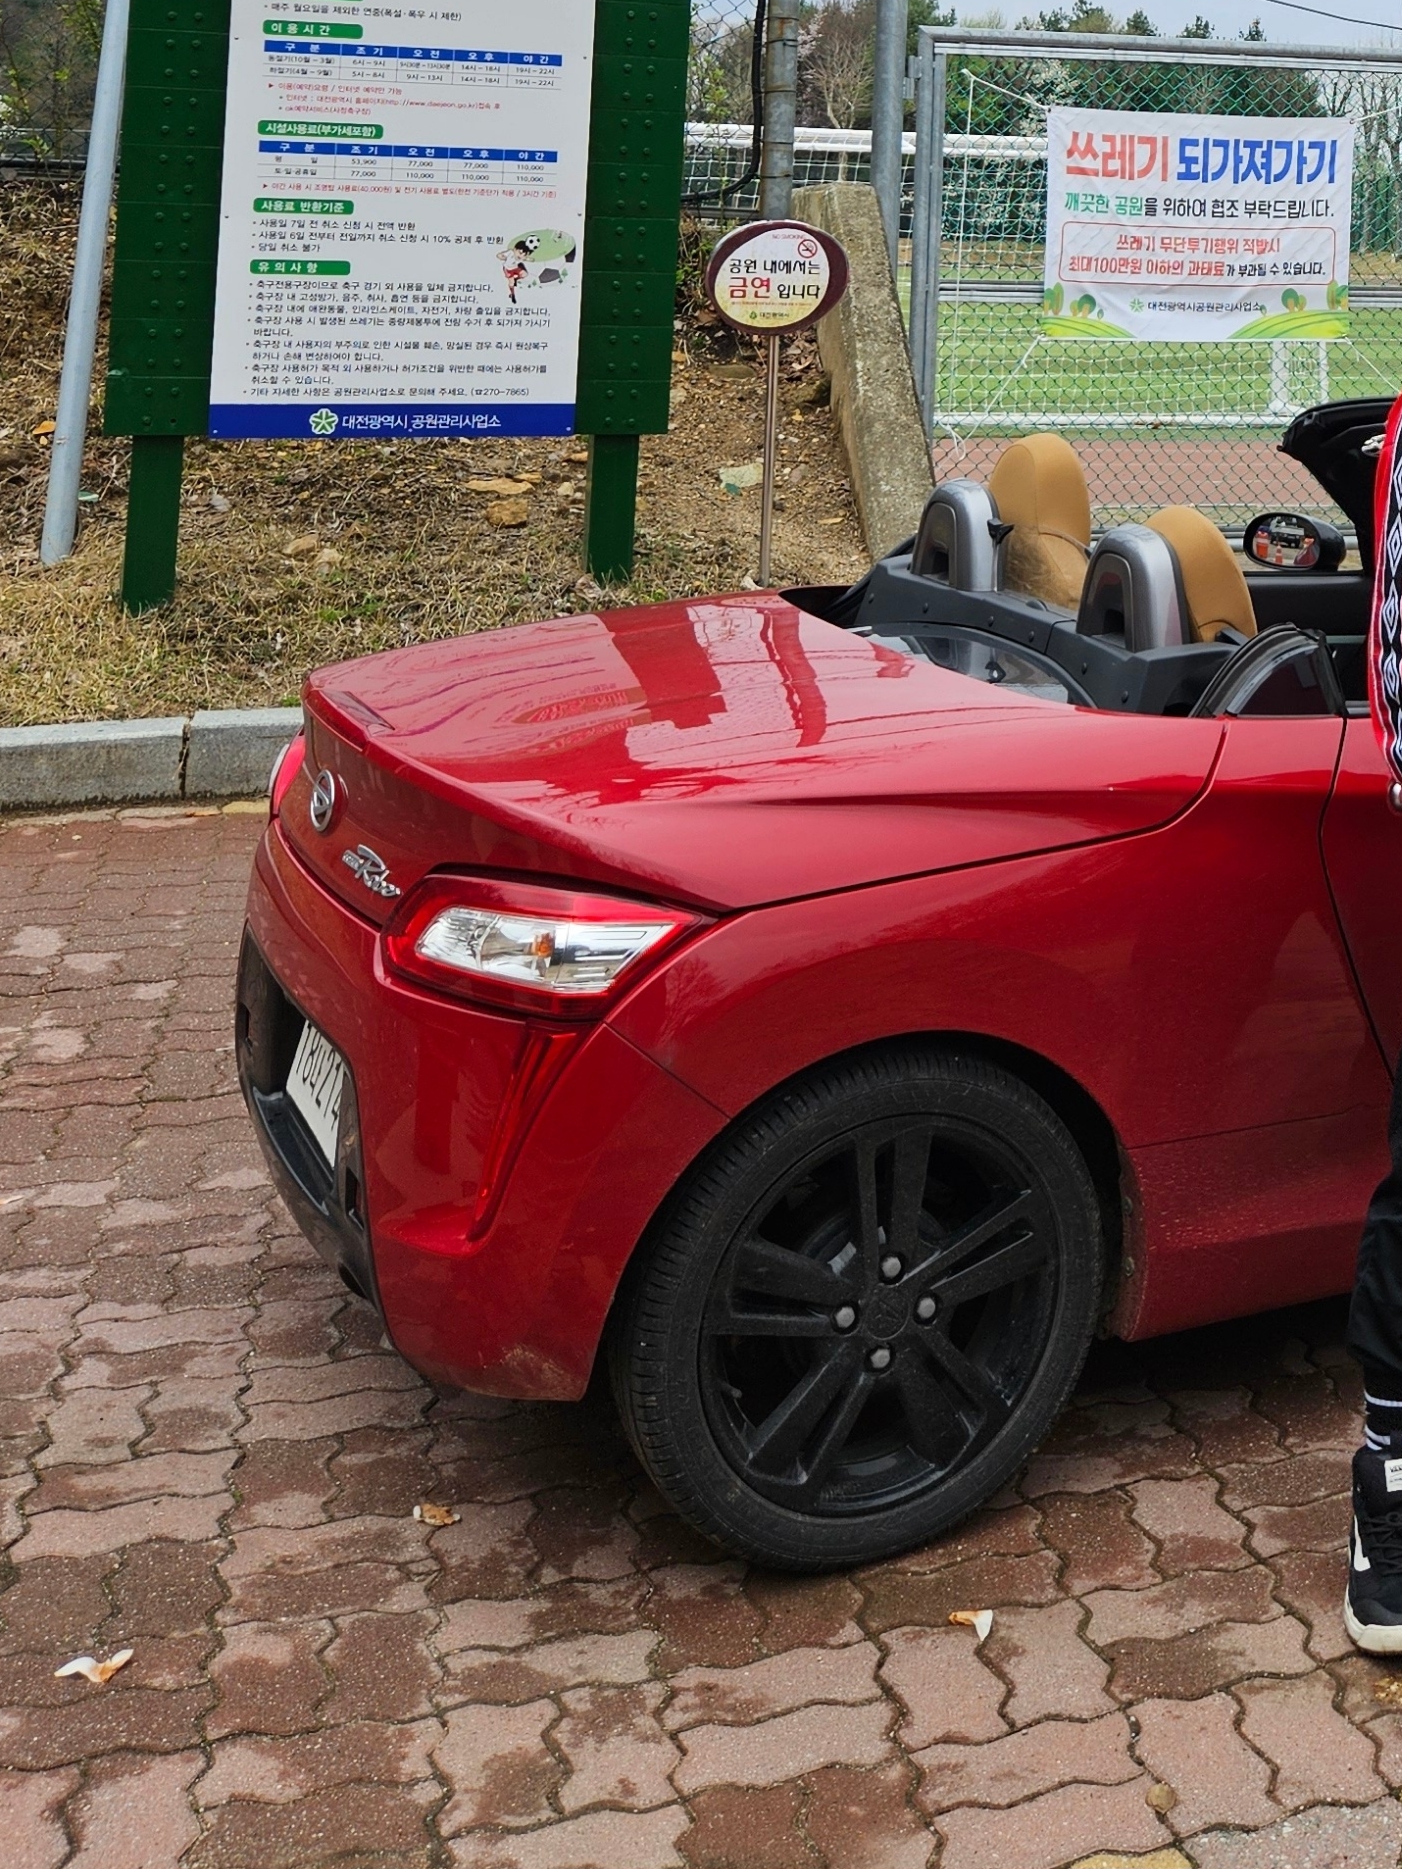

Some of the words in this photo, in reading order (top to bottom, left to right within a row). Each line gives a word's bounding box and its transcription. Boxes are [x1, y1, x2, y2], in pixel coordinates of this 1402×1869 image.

[1066, 131, 1169, 182] 쓰레기
[1177, 137, 1338, 185] 되가져가기
[1064, 192, 1109, 214] 깨끗한
[1114, 196, 1158, 216] 공원을
[1162, 197, 1207, 218] 위하여
[1211, 199, 1239, 218] 협조
[1243, 199, 1335, 219] 부탁드립니다.
[1116, 234, 1156, 252] 쓰레기
[1159, 236, 1239, 254] 무단투기행위
[1243, 237, 1281, 254] 적발시
[730, 258, 757, 274] 공원
[763, 259, 820, 275] 내에서는
[1068, 255, 1143, 276] 최대100만원
[1146, 258, 1183, 276] 이하의
[1187, 259, 1235, 277] 과태료가
[1238, 262, 1267, 277] 부과될
[1269, 262, 1281, 277] 수
[1282, 261, 1326, 277] 있습니다.
[729, 276, 770, 298] 금연
[777, 283, 820, 299] 입니다
[341, 414, 408, 430] 대전광역시
[410, 413, 502, 429] 공원관리사업소
